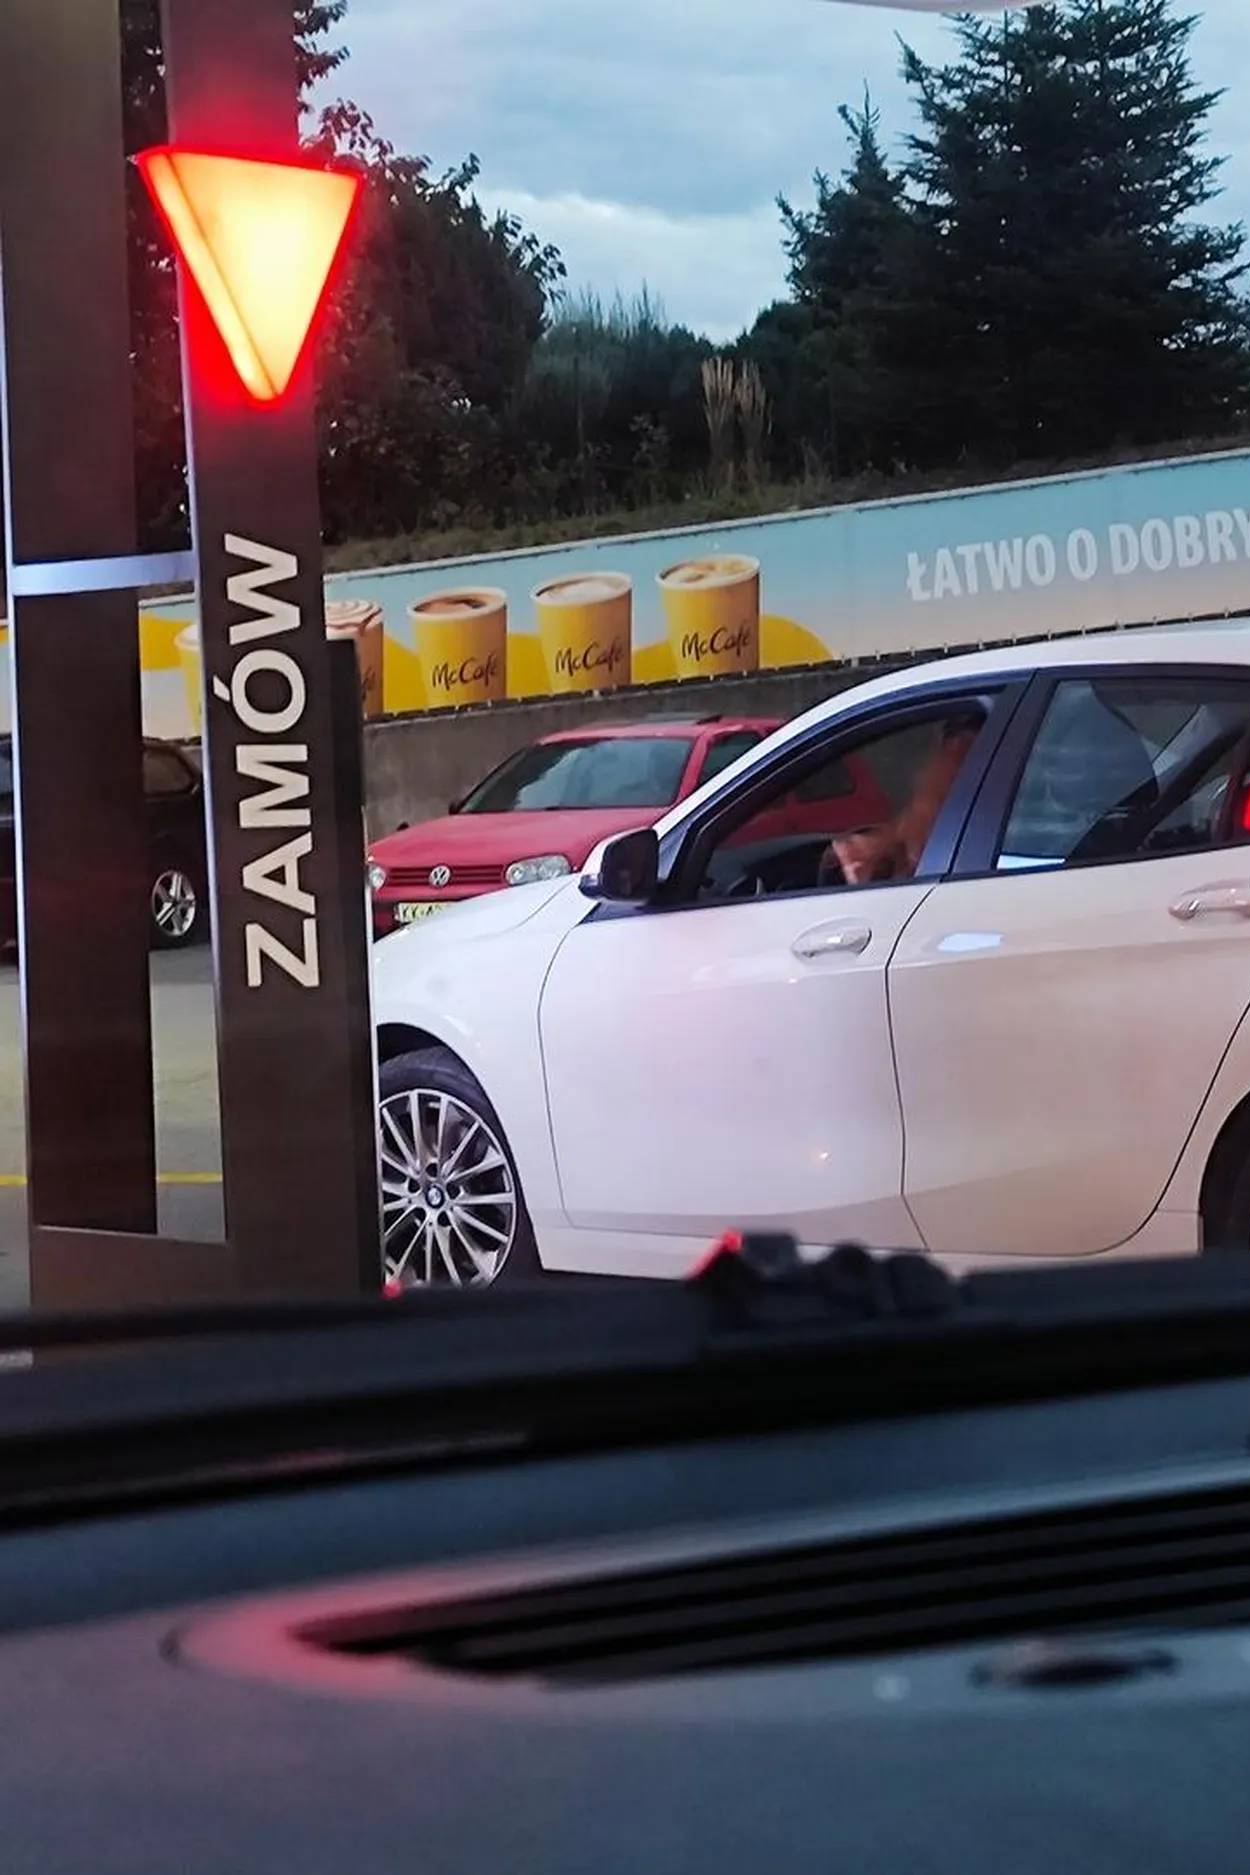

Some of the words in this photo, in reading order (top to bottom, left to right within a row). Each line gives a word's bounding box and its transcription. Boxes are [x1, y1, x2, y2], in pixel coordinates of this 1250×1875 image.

[906, 533, 1056, 602] ŁATWO
[1066, 528, 1098, 582] O
[212, 533, 320, 988] ZAMÓW
